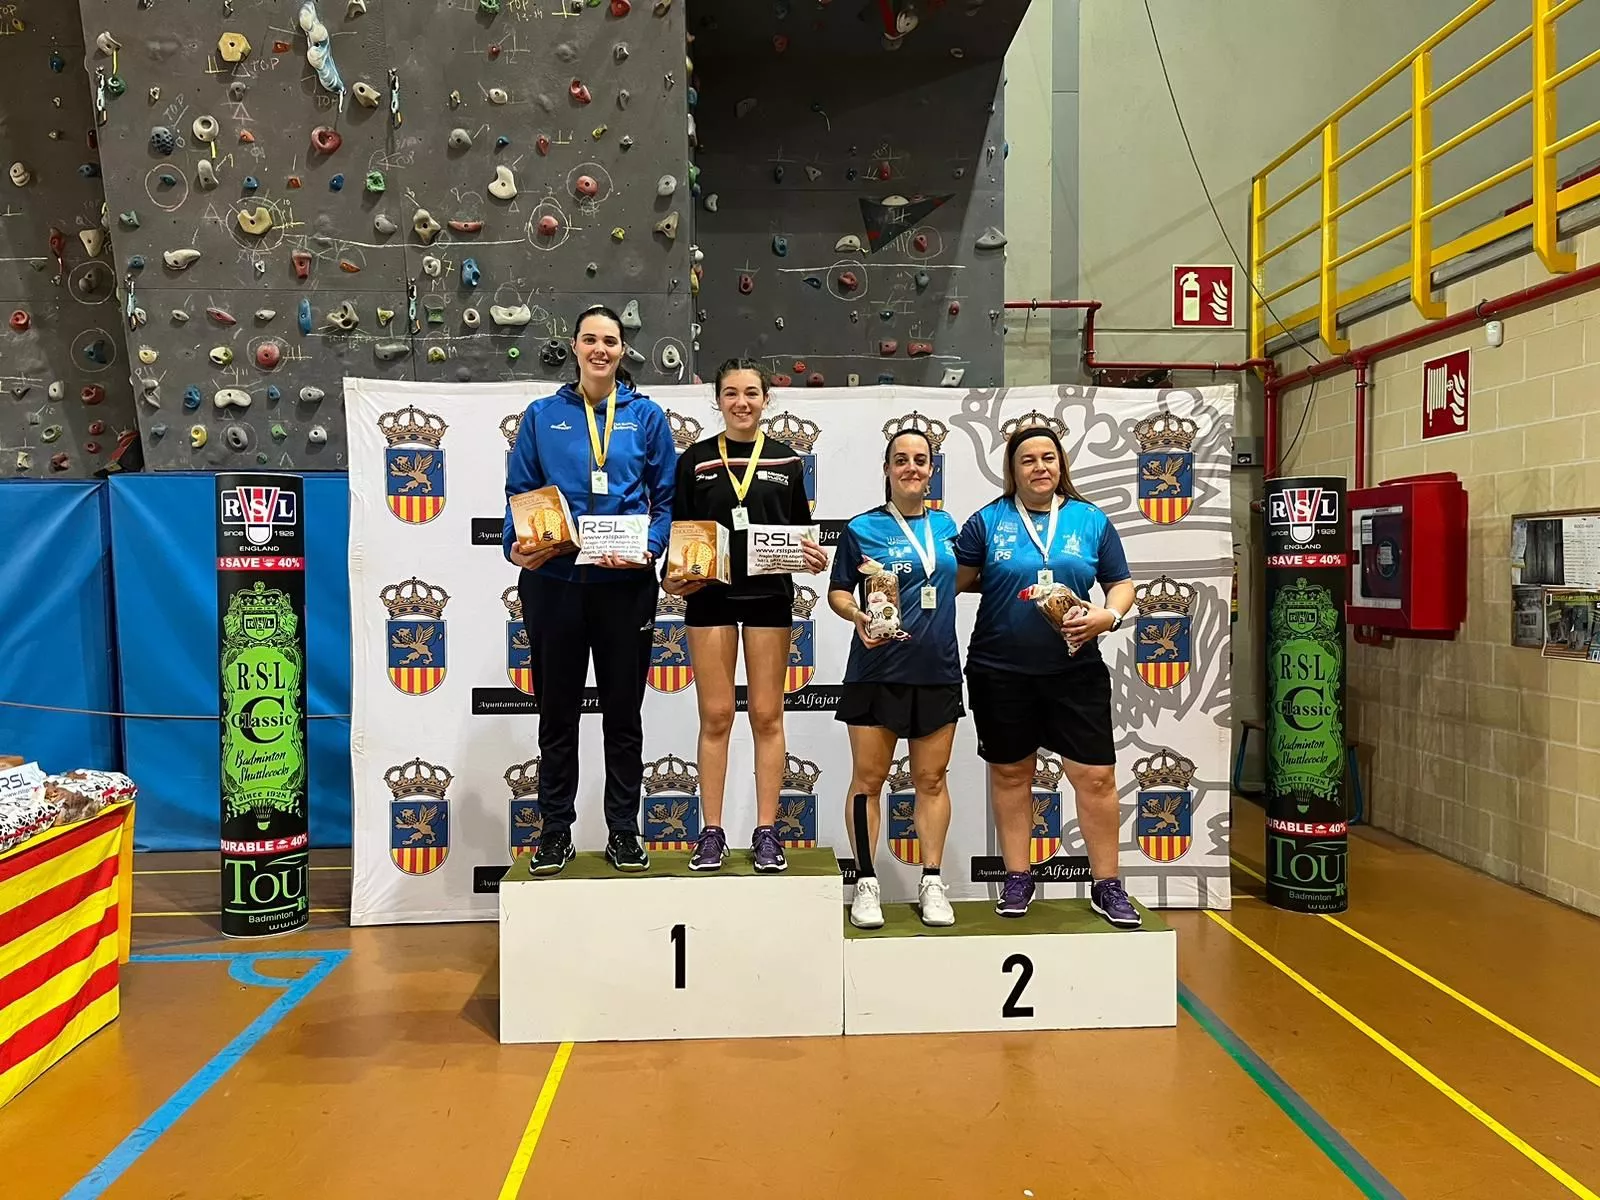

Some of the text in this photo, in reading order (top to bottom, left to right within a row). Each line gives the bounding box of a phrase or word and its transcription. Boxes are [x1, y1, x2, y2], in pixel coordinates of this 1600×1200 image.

[251, 57, 280, 71] TOP
[582, 521, 625, 535] RSL
[754, 532, 798, 546] RSL
[226, 558, 260, 568] SAVE
[278, 557, 300, 568] 40%
[1272, 555, 1303, 565] SAVE
[1320, 554, 1341, 565] 40%
[478, 701, 534, 709] Ayuntamiento
[1275, 700, 1332, 716] Classic
[231, 711, 293, 729] Classic
[1278, 735, 1325, 752] Badminton
[235, 750, 287, 769] Badminton
[1281, 749, 1328, 768] Shuttlecocks
[238, 763, 290, 785] Shuttlecocks
[238, 790, 287, 802] since 1928
[1328, 822, 1346, 833] 40%
[290, 833, 308, 847] 40%
[1289, 890, 1332, 901] Badminton
[248, 911, 294, 923] Badminton
[671, 924, 686, 989] 1
[1001, 953, 1034, 1018] 2
